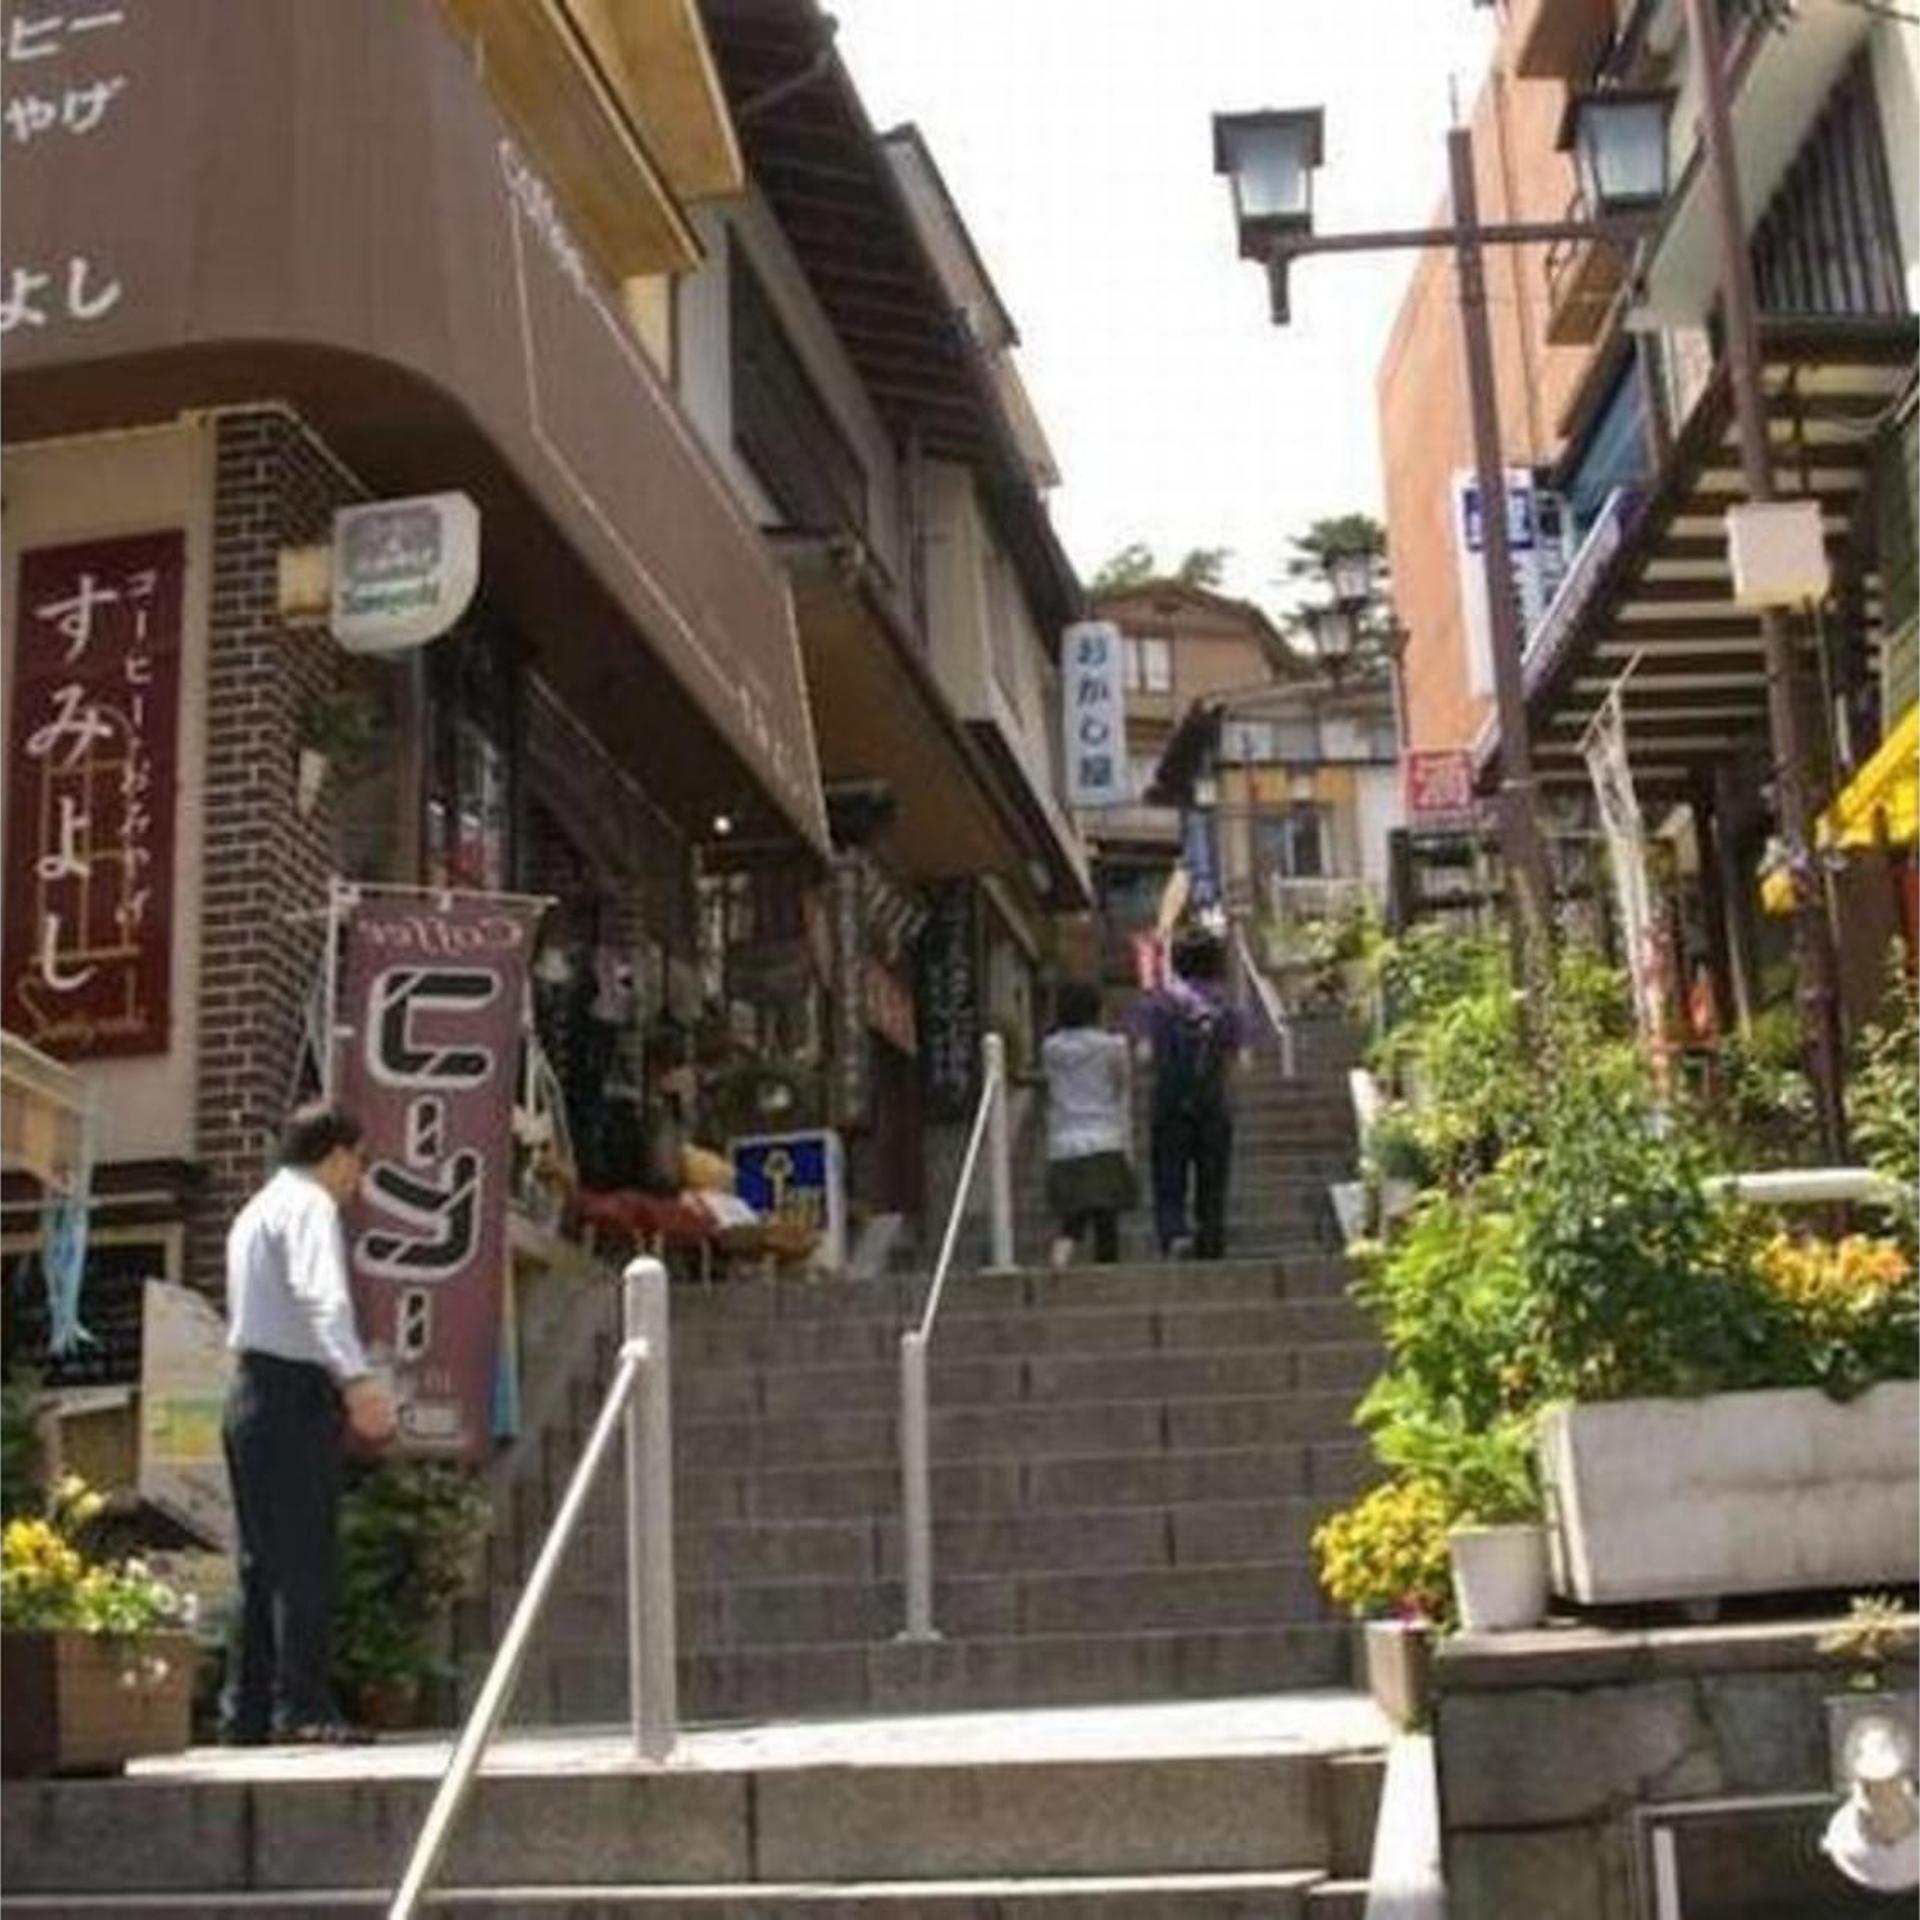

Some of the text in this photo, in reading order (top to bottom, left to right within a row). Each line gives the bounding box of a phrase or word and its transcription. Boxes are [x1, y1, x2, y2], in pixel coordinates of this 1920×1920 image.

[0, 257, 122, 332] よし
[26, 573, 118, 991] すみよし
